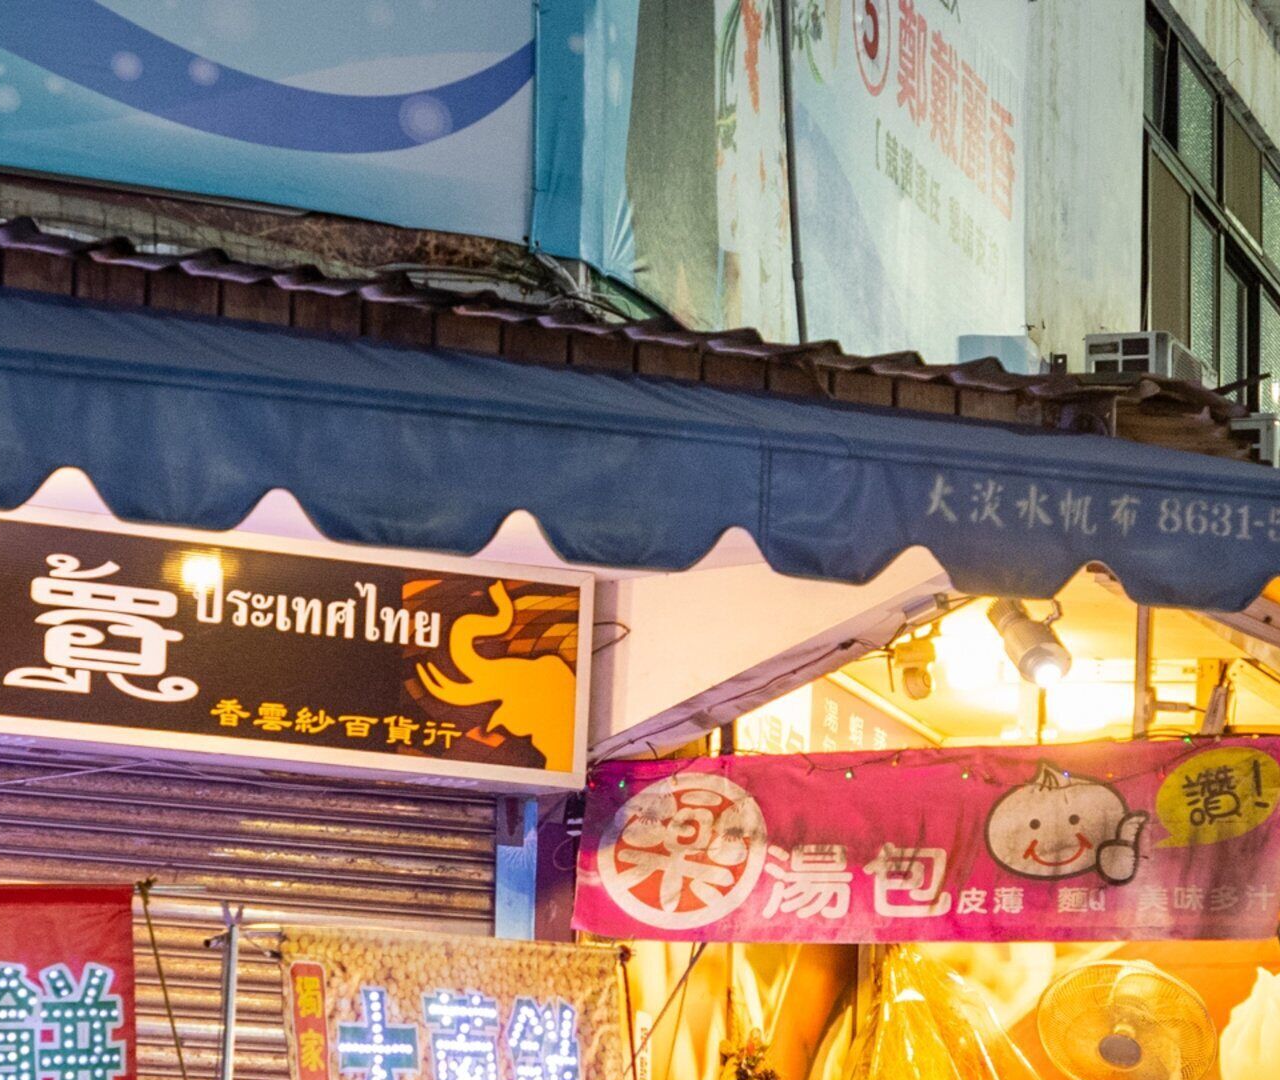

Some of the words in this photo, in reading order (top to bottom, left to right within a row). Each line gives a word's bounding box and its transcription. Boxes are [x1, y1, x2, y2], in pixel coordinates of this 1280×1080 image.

[926, 474, 1141, 536] 大淡水帆布
[193, 572, 441, 648] ประเทศไทย
[761, 842, 951, 919] 湯包
[956, 887, 1025, 915] 皮薄
[1138, 885, 1276, 913] 美味多汁
